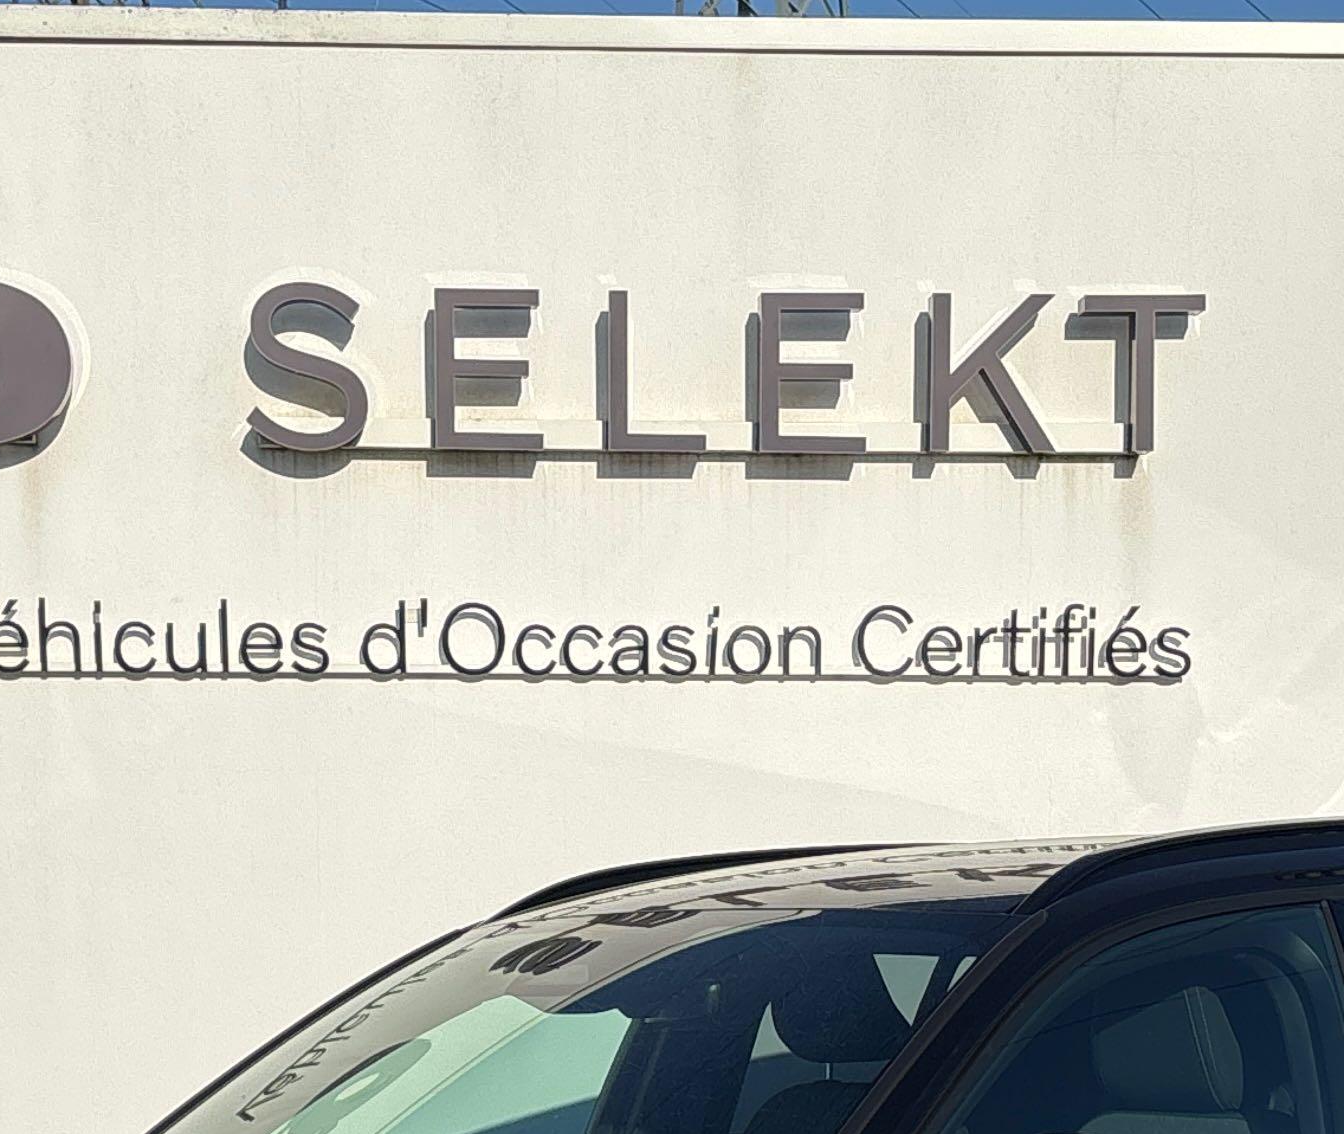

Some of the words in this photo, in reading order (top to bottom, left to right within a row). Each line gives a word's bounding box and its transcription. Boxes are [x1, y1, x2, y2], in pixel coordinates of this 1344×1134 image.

[244, 281, 1206, 455] SELEKT
[360, 597, 822, 677] d'Occasion
[857, 603, 1193, 679] Certifiés
